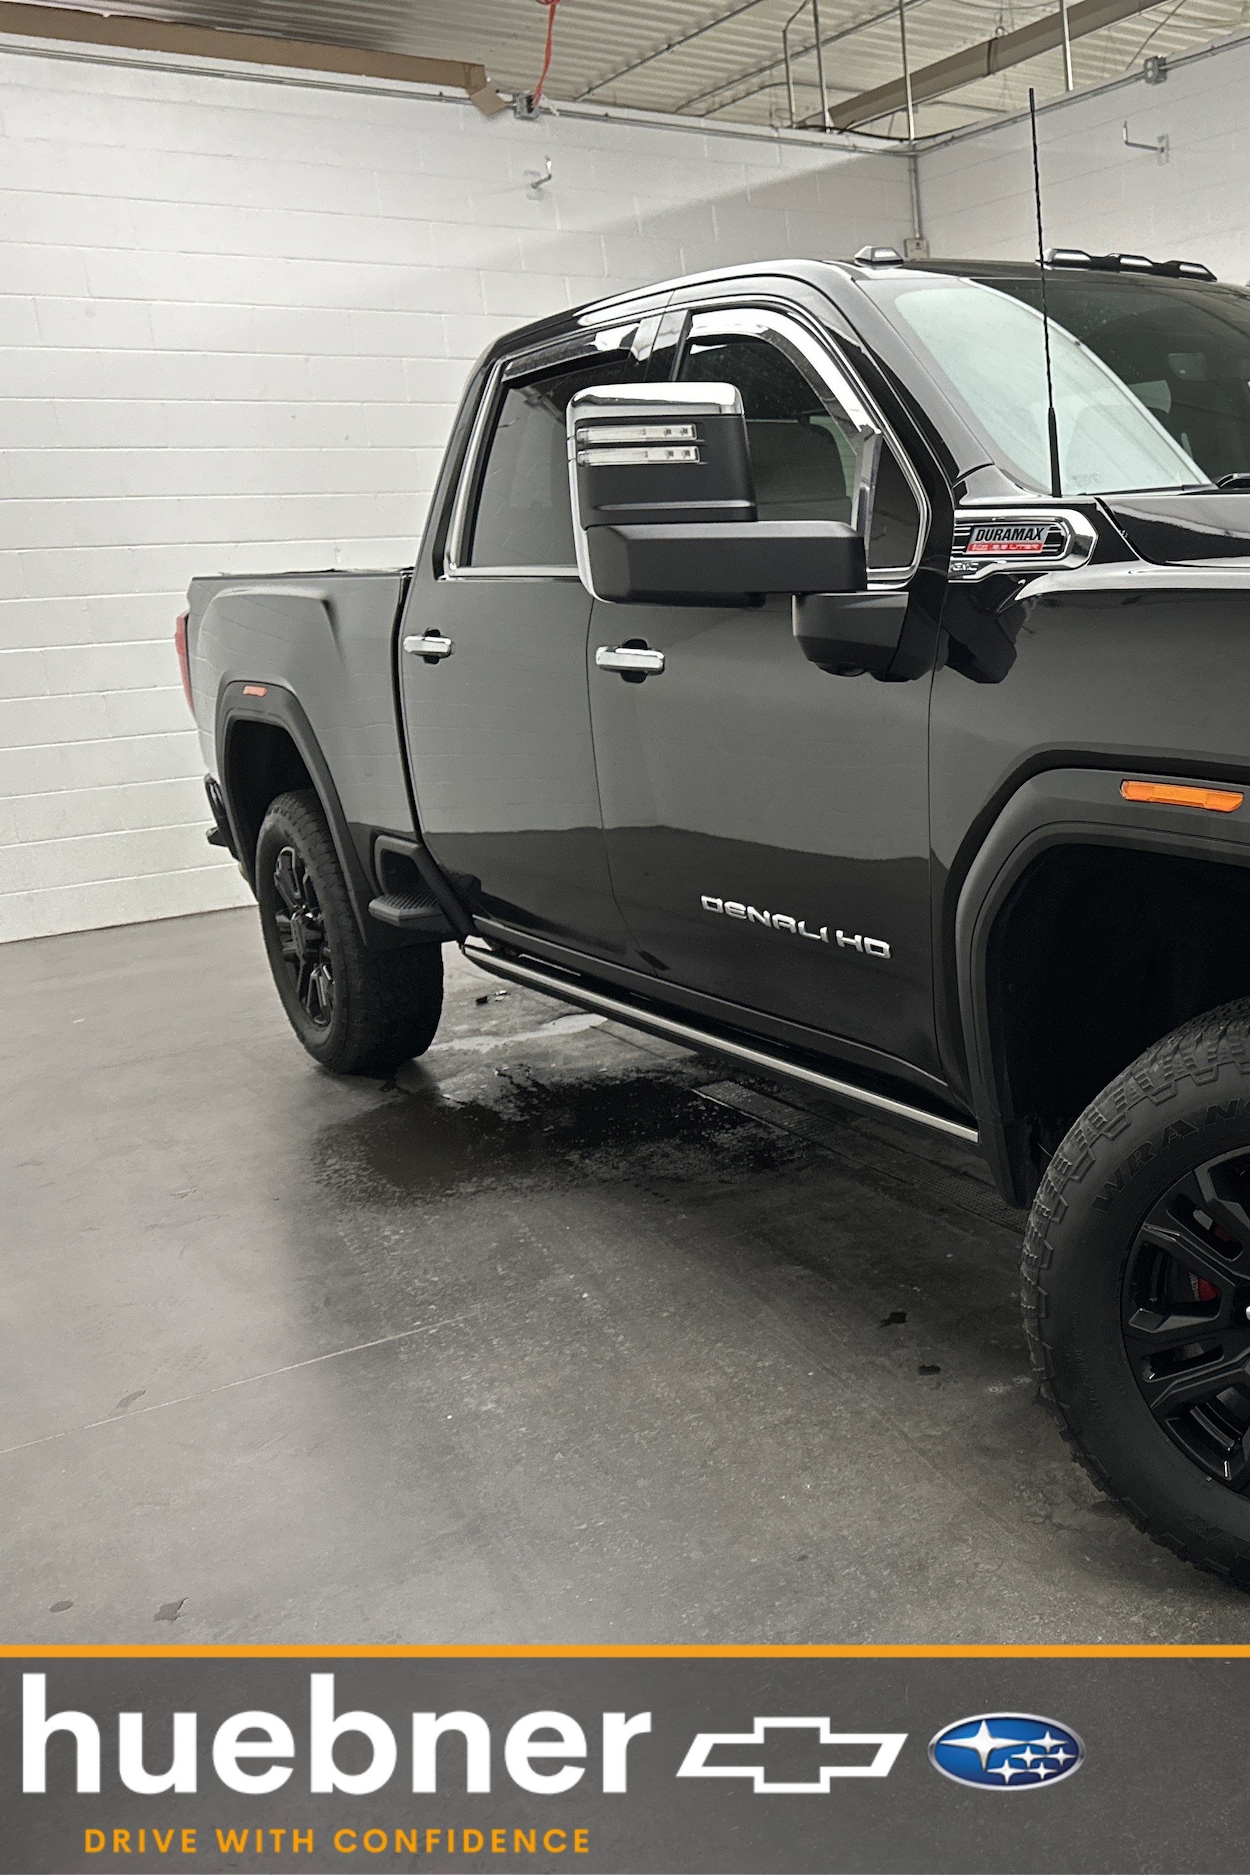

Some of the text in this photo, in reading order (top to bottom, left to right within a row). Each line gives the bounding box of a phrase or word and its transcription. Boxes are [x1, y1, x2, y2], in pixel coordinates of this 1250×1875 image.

[974, 527, 1045, 542] DURAMAX
[952, 561, 980, 572] GMC
[700, 894, 892, 960] DENALI HD
